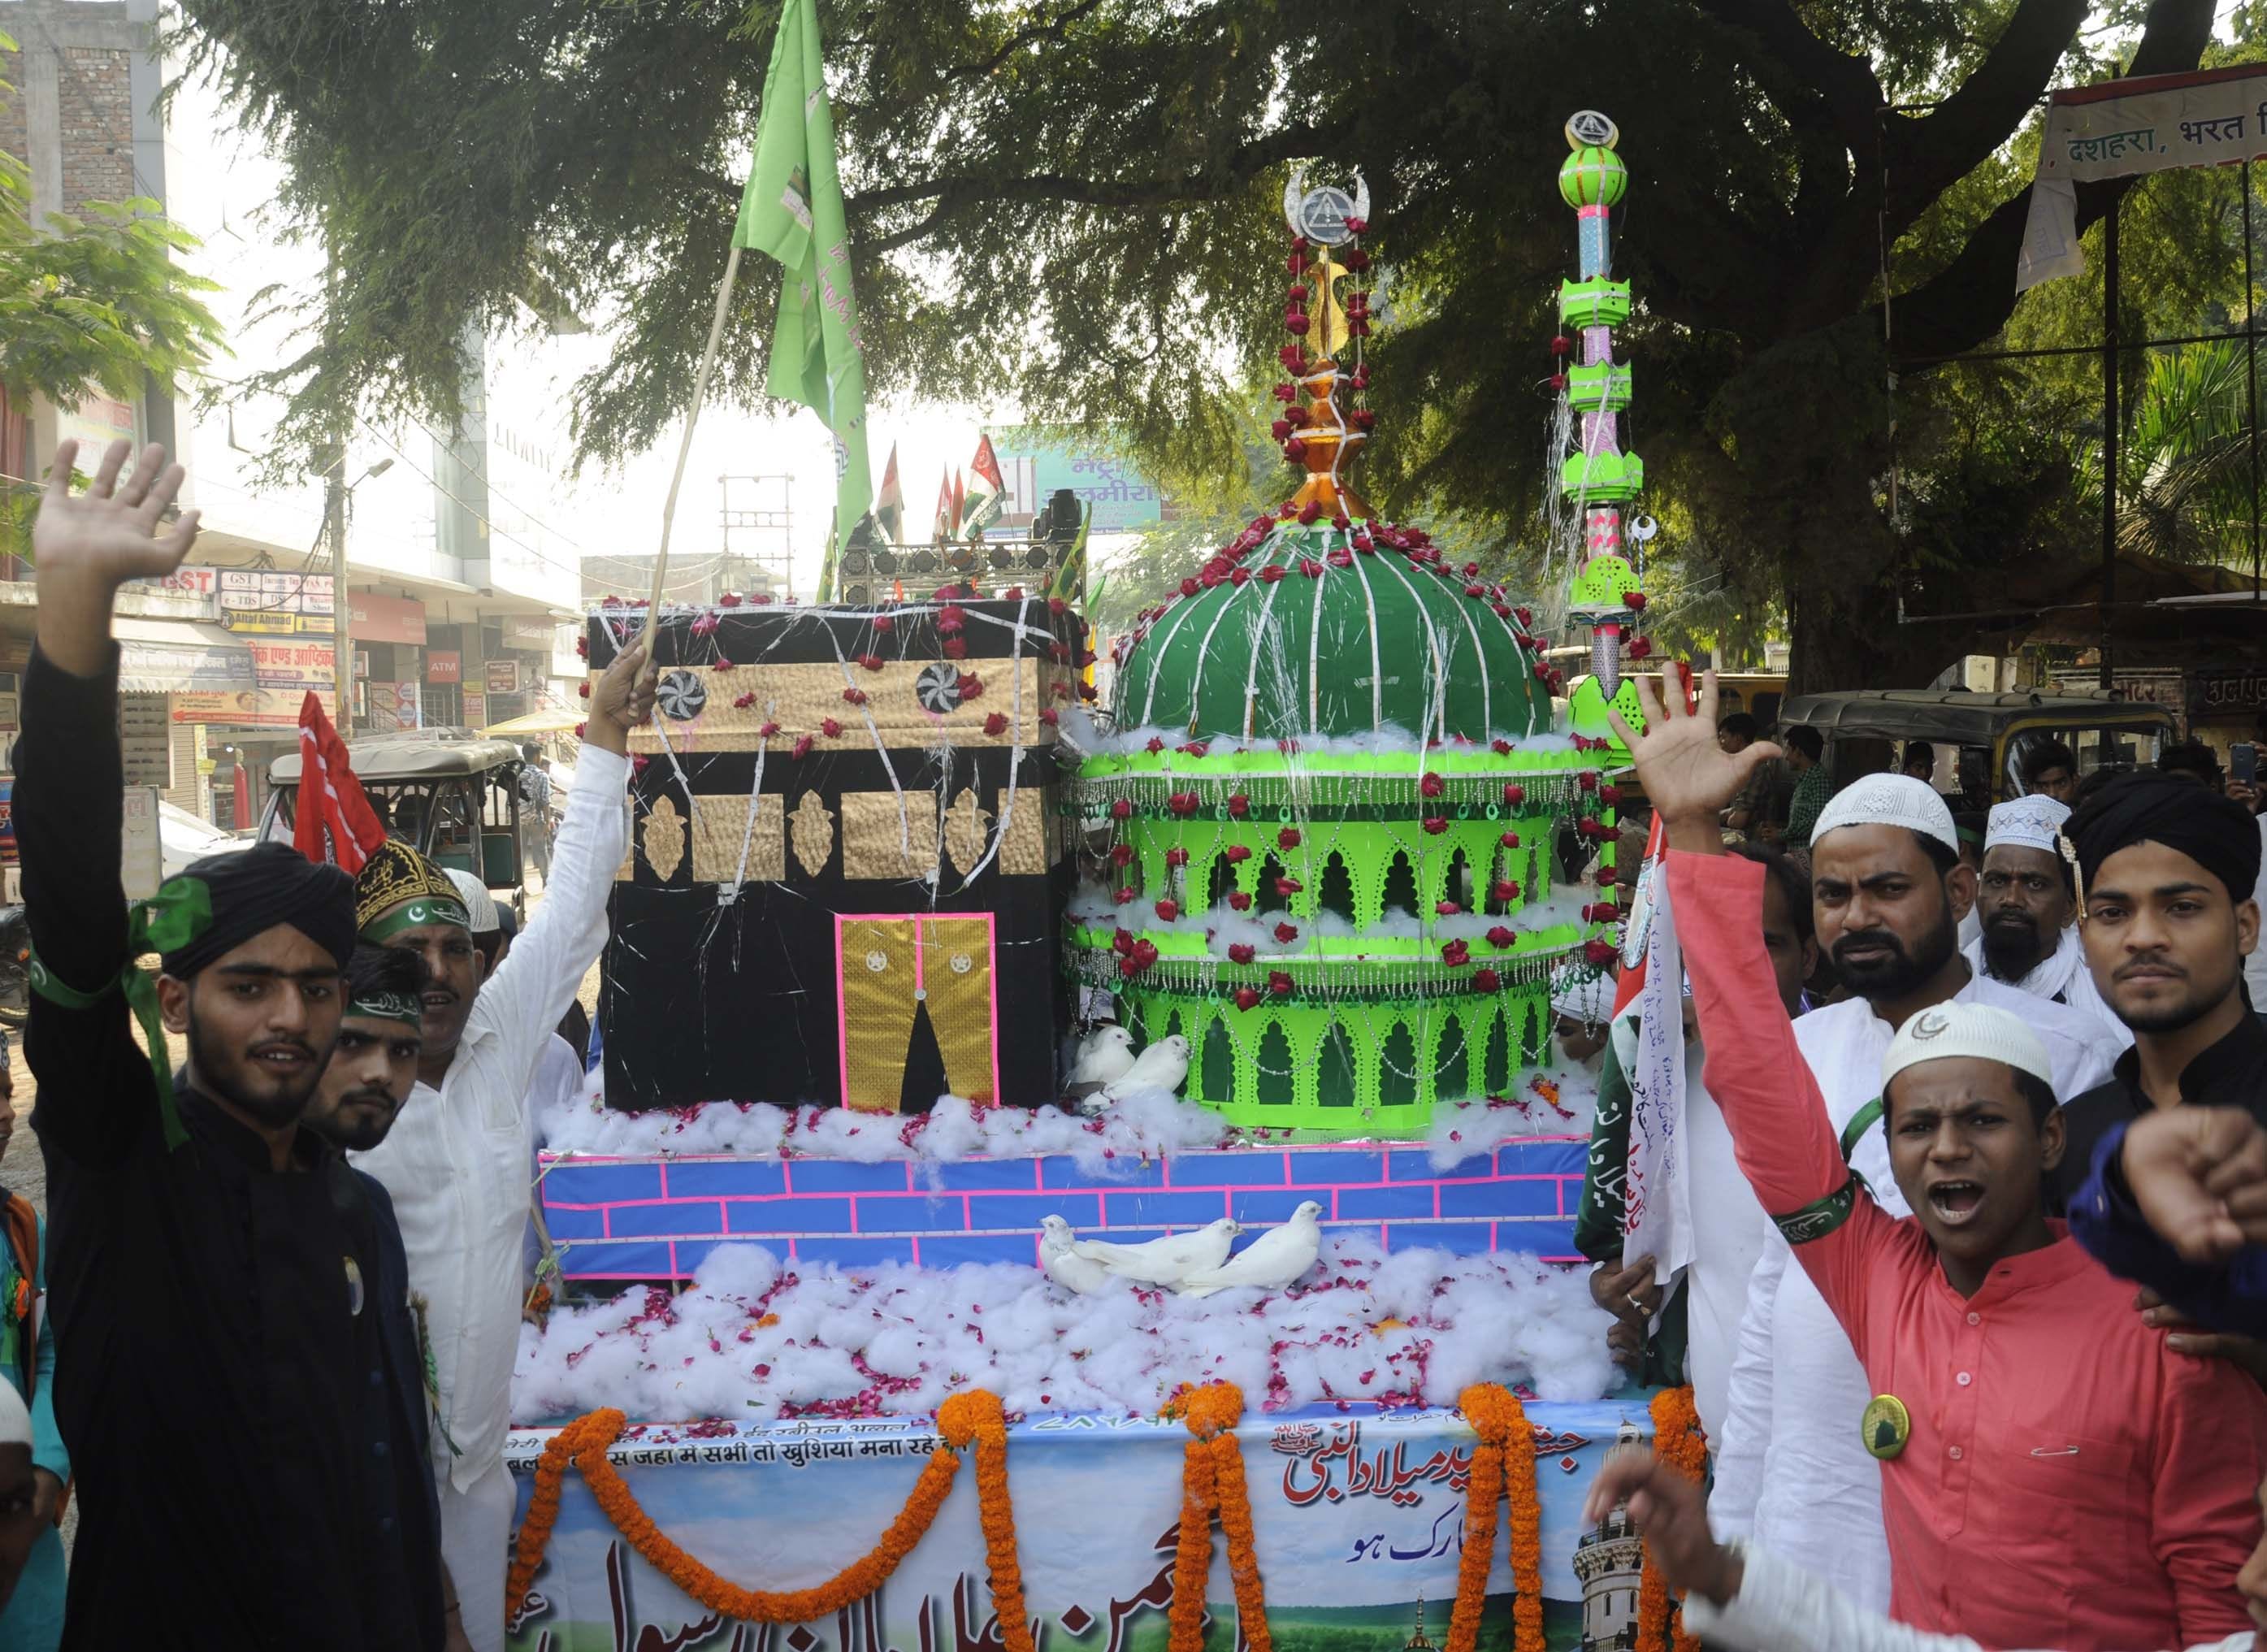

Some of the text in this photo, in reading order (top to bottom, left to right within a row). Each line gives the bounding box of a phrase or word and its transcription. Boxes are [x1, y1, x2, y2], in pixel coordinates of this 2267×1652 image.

[2068, 128, 2167, 163] दशहरा,
[2180, 115, 2245, 145] भरत
[160, 570, 212, 594] GST
[230, 574, 254, 584] GST
[235, 613, 257, 624] Altaf
[259, 614, 291, 625] Ahmad
[271, 647, 291, 665] एण्ड
[431, 662, 456, 672] ATM
[703, 1442, 748, 1462] सभी
[752, 1441, 776, 1461] तो
[781, 1437, 853, 1468] खुशियां
[858, 1437, 903, 1456] मना
[908, 1434, 936, 1455] रहे
